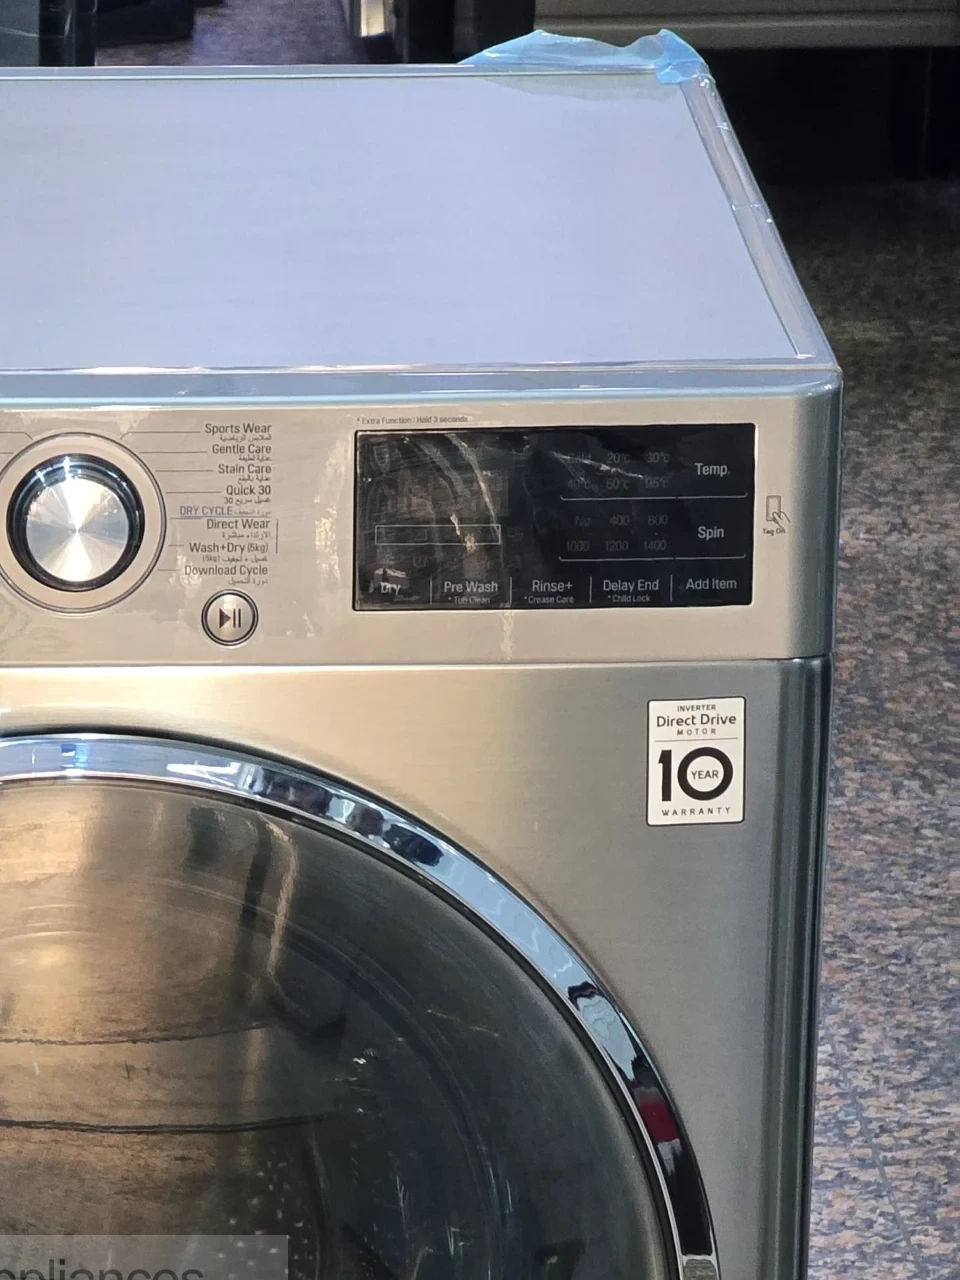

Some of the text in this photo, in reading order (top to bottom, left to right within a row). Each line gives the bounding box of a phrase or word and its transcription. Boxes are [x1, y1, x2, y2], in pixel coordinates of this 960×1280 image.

[382, 416, 412, 424] Function
[417, 416, 432, 424] Hold
[439, 415, 469, 423] seconds
[205, 423, 272, 435] Sports Wear
[212, 443, 272, 454] Gentle Care
[218, 463, 272, 474] Stain Care
[695, 462, 731, 477] Temp.
[226, 484, 272, 496] Quick 30
[180, 505, 233, 516] DRY CYCLE
[206, 518, 270, 529] Direct Wear
[698, 526, 724, 540] Spin
[189, 543, 269, 554] Wash+Dry (5kg)
[185, 565, 269, 577] Download Cycle
[380, 582, 401, 595] Dry
[444, 581, 499, 593] Pre Wash
[532, 580, 573, 592] Rinse+
[603, 579, 659, 592] Delay End
[686, 578, 738, 590] Add Item
[528, 595, 574, 604] Crease Care
[612, 594, 651, 603] Child Lock
[677, 704, 717, 712] INVERTER
[656, 713, 737, 727] Direct Drive
[677, 728, 717, 736] MOTOR
[658, 746, 734, 802] 10
[691, 769, 719, 780] YEAR
[661, 807, 731, 817] WARRANTY
